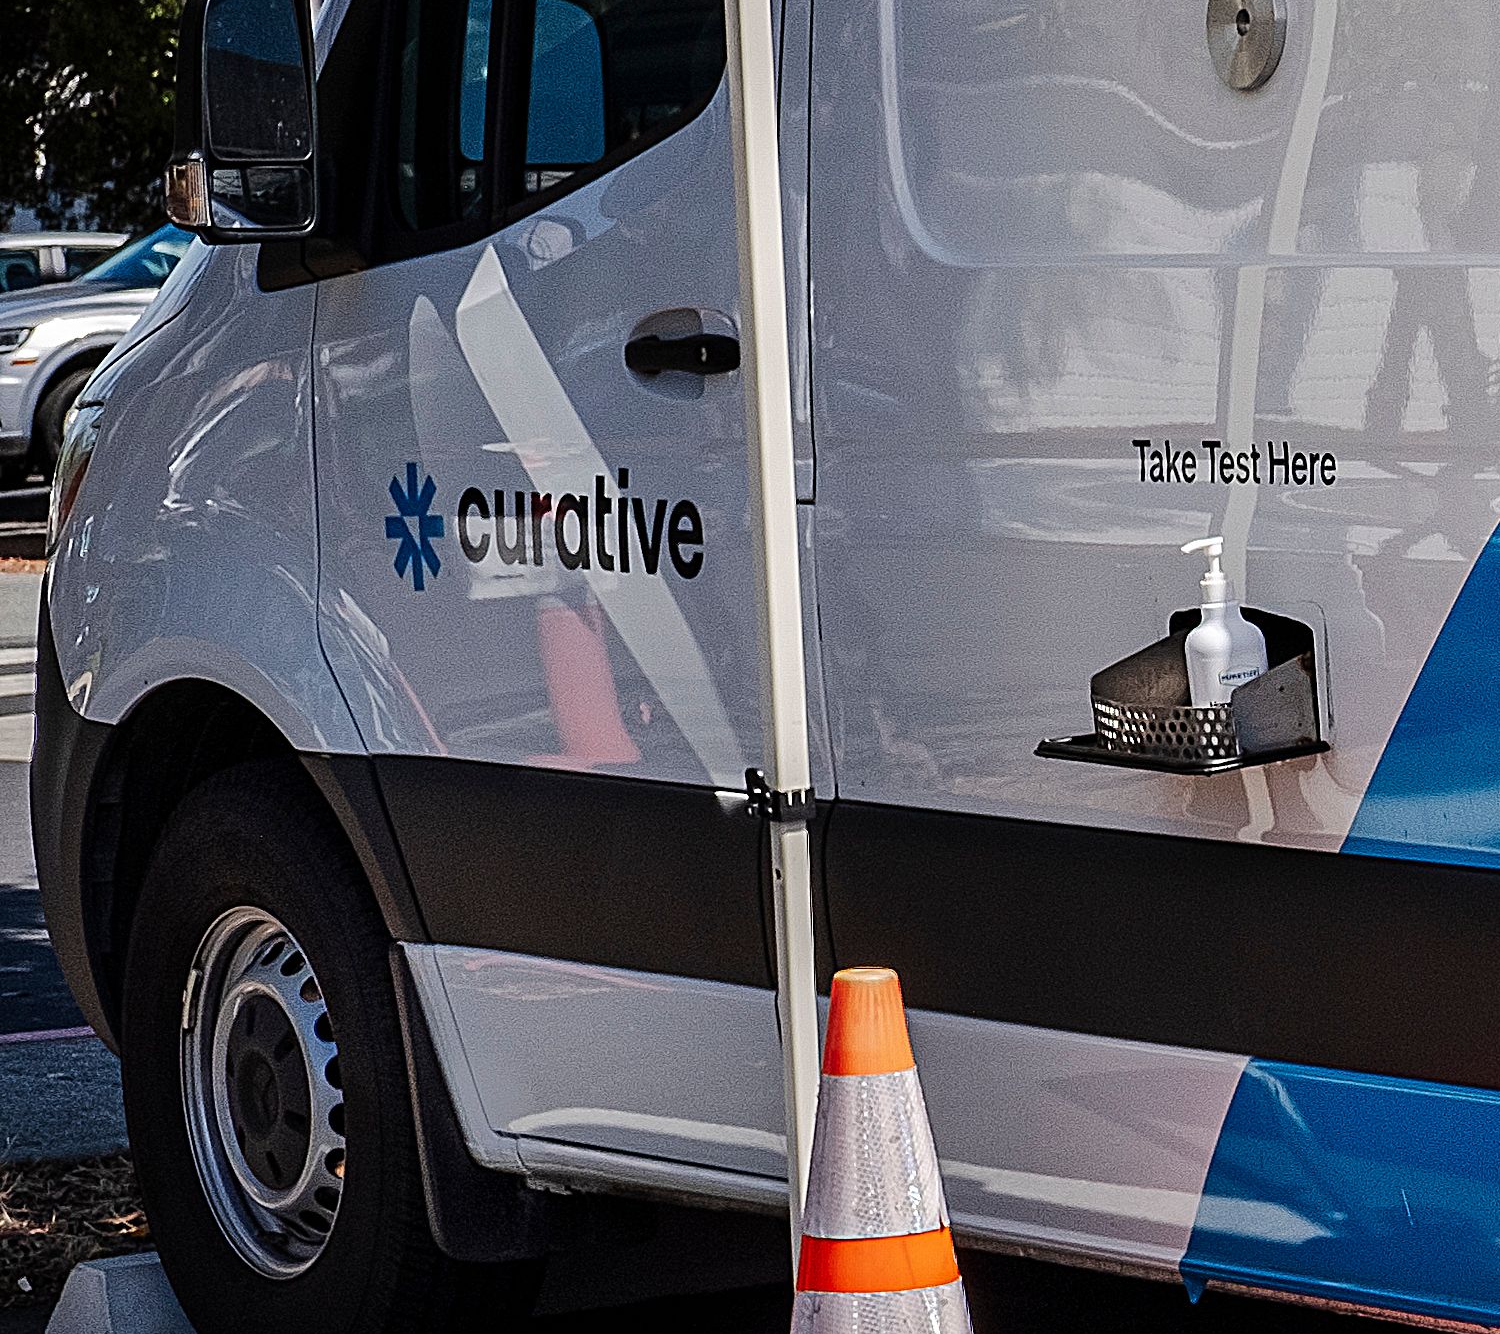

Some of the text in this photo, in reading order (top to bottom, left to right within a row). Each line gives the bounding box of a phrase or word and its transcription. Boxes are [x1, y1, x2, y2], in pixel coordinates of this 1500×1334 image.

[1132, 439, 1337, 486] Take Test Here
[457, 467, 704, 580] curative
